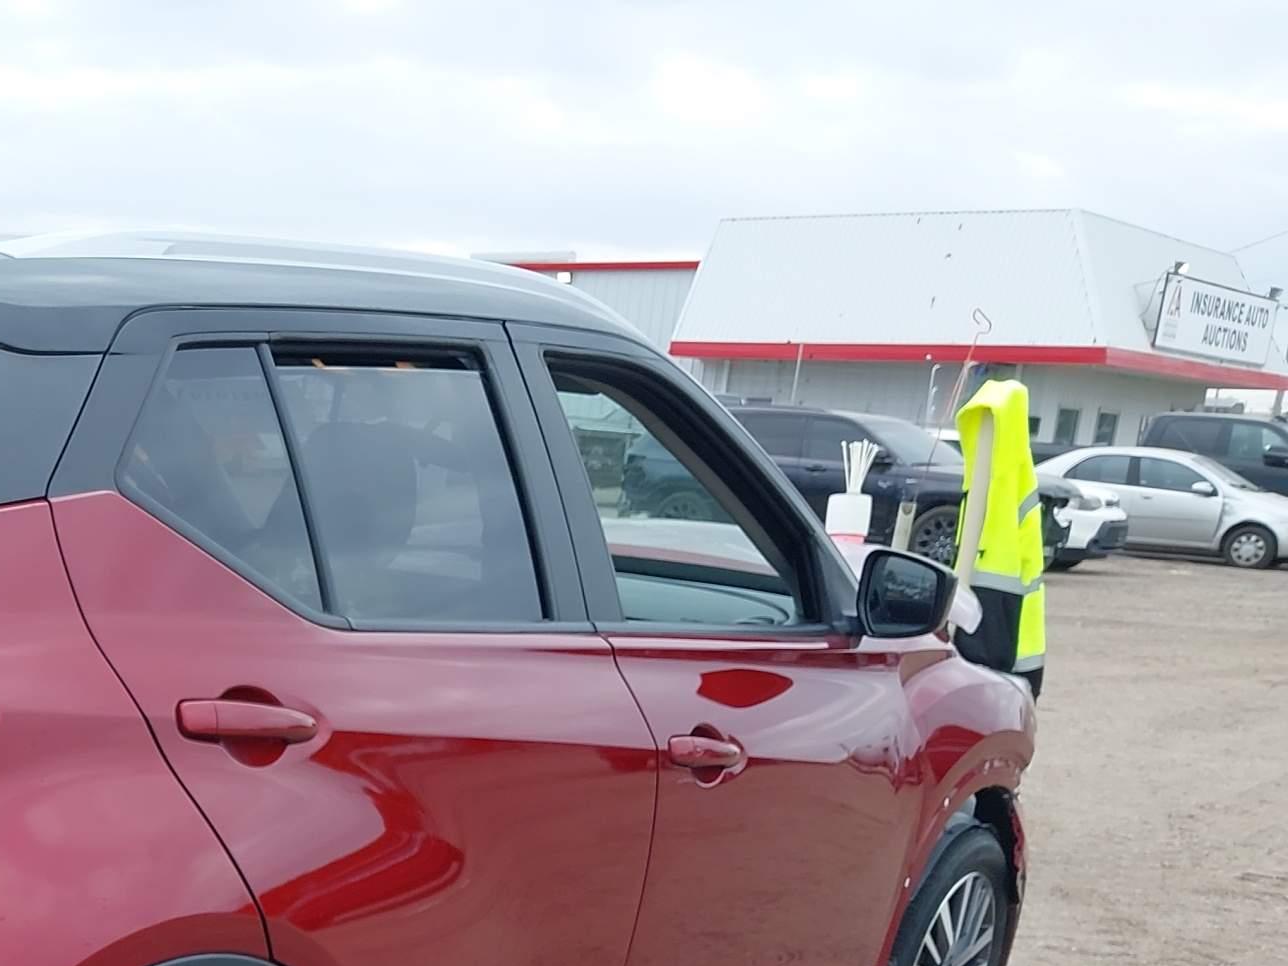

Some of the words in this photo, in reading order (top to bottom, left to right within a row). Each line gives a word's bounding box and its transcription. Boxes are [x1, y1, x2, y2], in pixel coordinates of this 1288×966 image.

[1190, 291, 1245, 323] INSURANCE
[1244, 304, 1269, 329] AUTO
[1201, 323, 1249, 352] AUCTIONS
